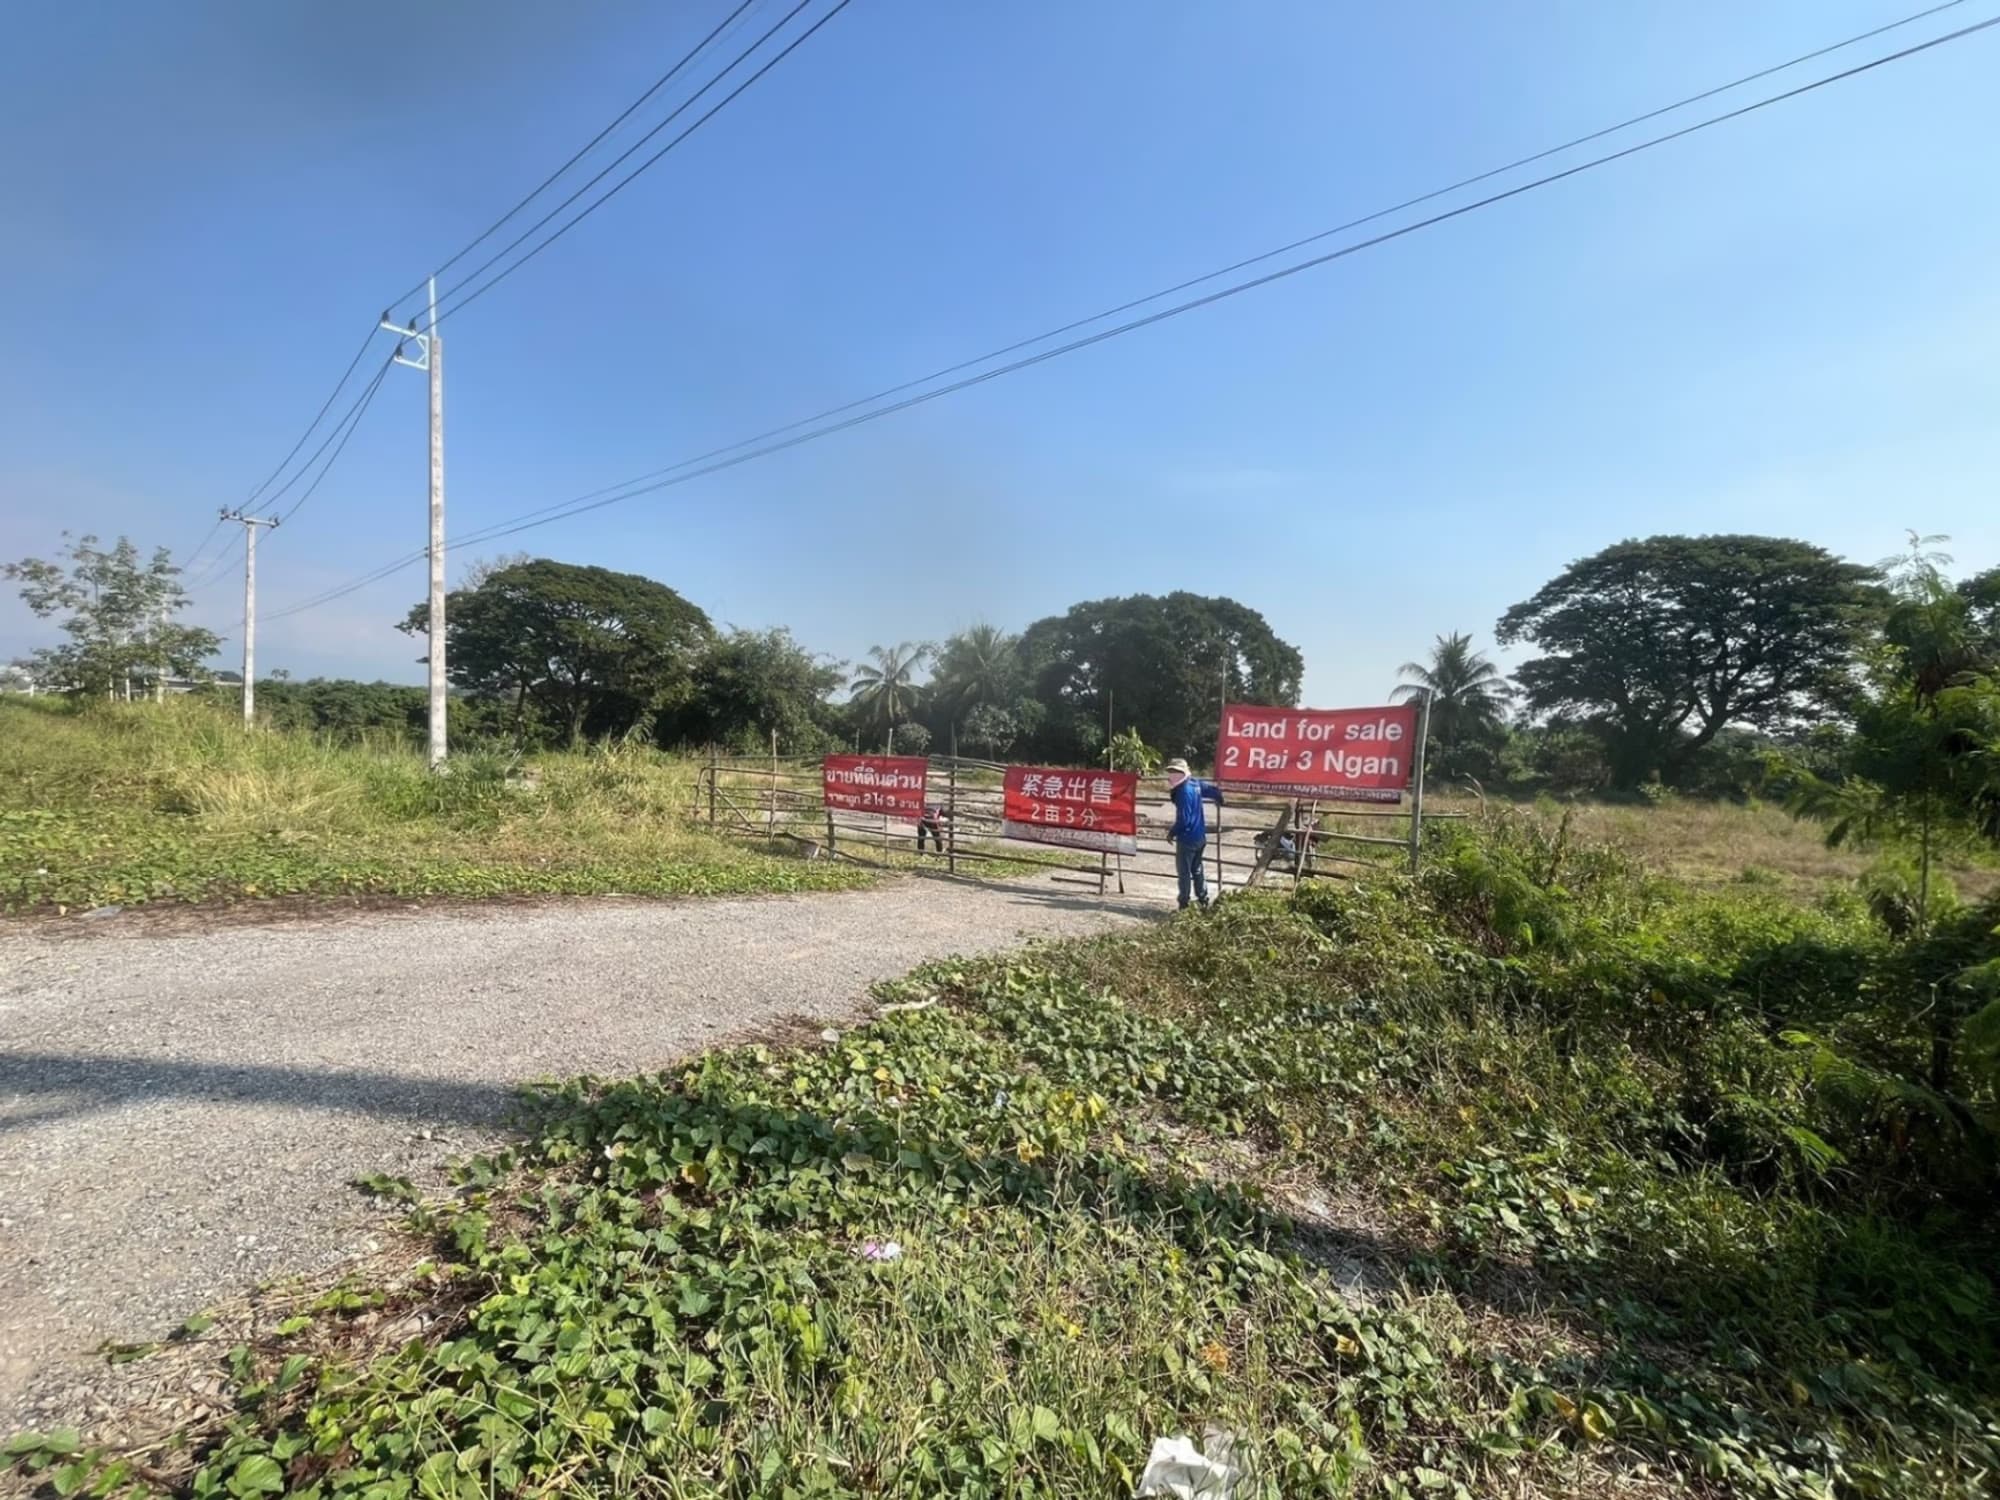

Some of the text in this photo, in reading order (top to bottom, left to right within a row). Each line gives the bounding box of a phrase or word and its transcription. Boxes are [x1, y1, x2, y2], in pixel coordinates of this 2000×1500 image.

[1227, 716, 1403, 741] Land for sale
[826, 761, 922, 789] ขายที่ดินด่วน
[1224, 746, 1399, 778] 2 Rai 3 Ngan
[863, 793, 872, 805] 2
[886, 795, 896, 807] 3
[1020, 773, 1113, 805] 紧急出售
